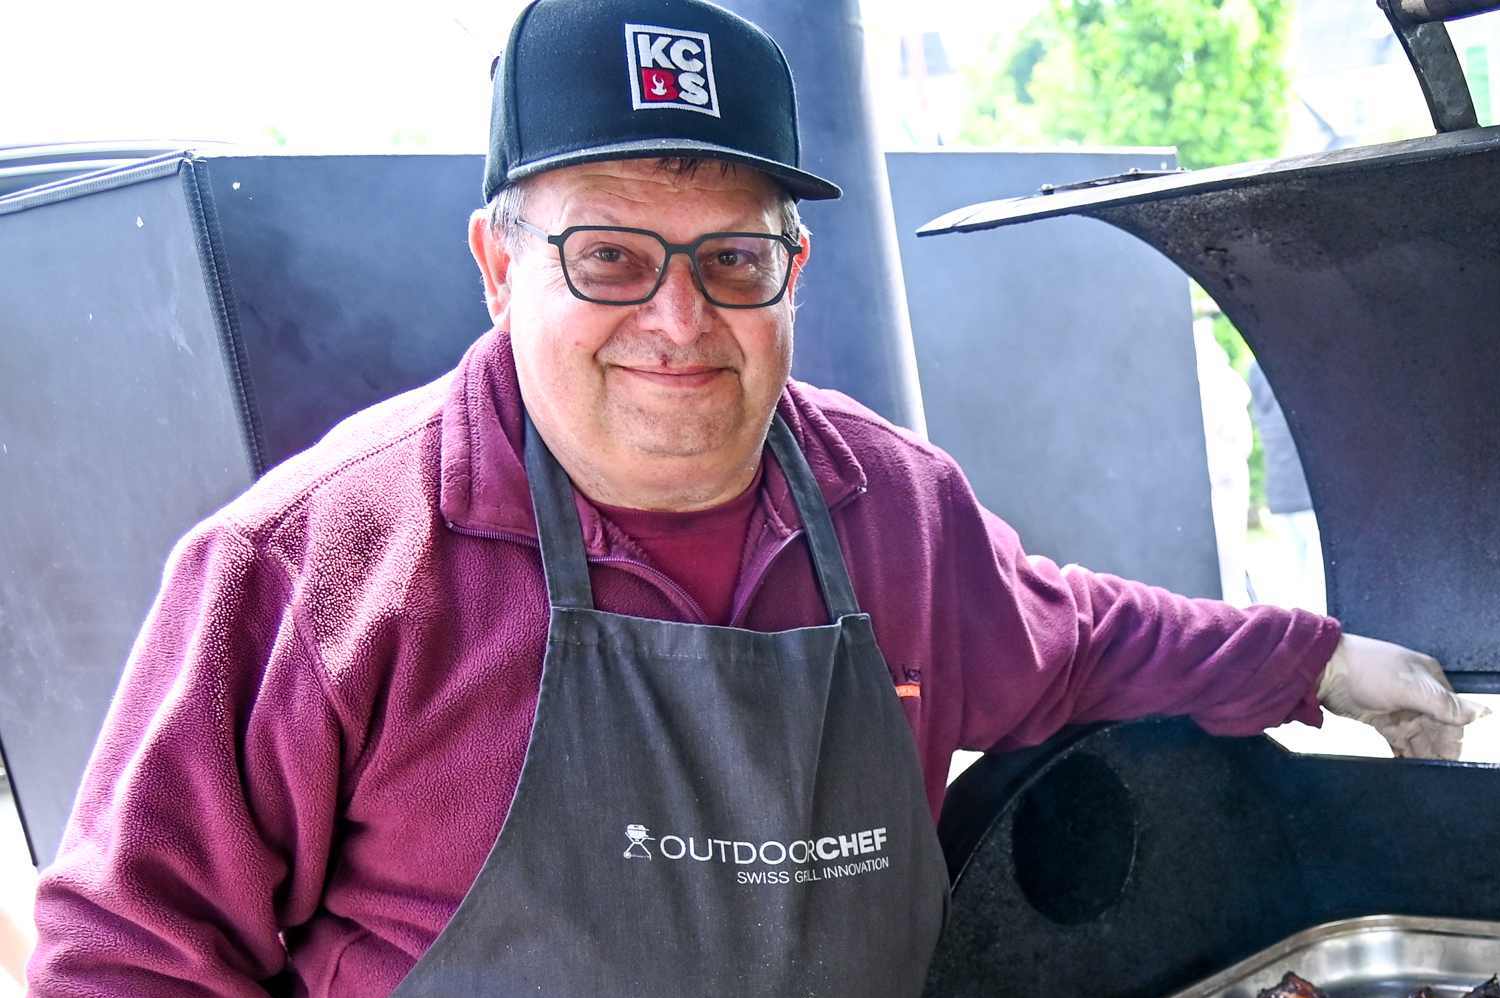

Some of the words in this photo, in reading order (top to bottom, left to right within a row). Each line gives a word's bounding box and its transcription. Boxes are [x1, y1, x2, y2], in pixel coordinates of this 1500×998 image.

[637, 34, 704, 72] KC
[660, 827, 887, 865] OUTDOORCHEF
[737, 870, 790, 885] SWISS
[823, 856, 889, 880] INNOVATION
